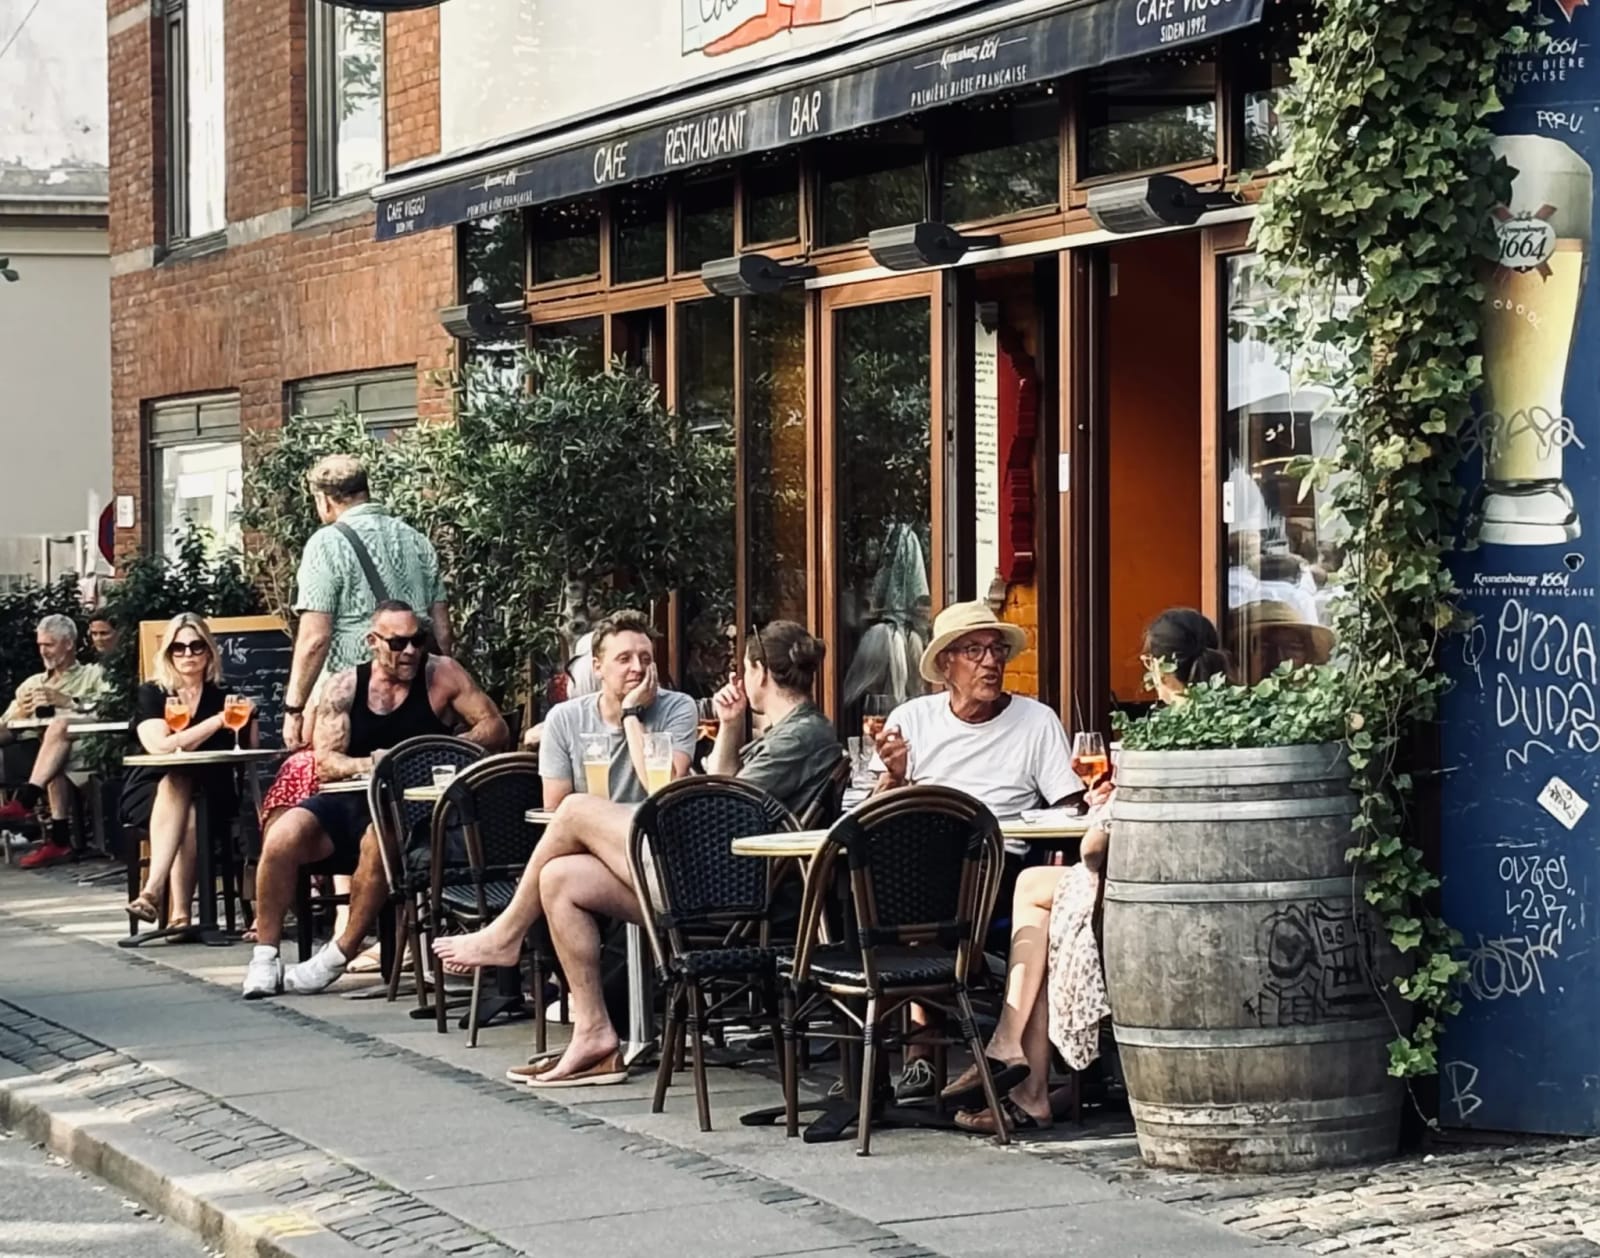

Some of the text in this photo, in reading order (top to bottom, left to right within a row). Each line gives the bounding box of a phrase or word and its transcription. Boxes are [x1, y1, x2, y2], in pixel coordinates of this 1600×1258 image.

[1160, 14, 1206, 43] SIDEN 1992
[1545, 38, 1579, 56] 1664
[1542, 55, 1585, 70] BIÈRE
[593, 90, 821, 185] CAFE RESTAURANT BAR
[1499, 232, 1547, 261] 1664
[1472, 571, 1569, 588] Kronenbourg 1664
[1502, 586, 1531, 597] BIÈRE
[1535, 586, 1595, 598] FRANÇAISE
